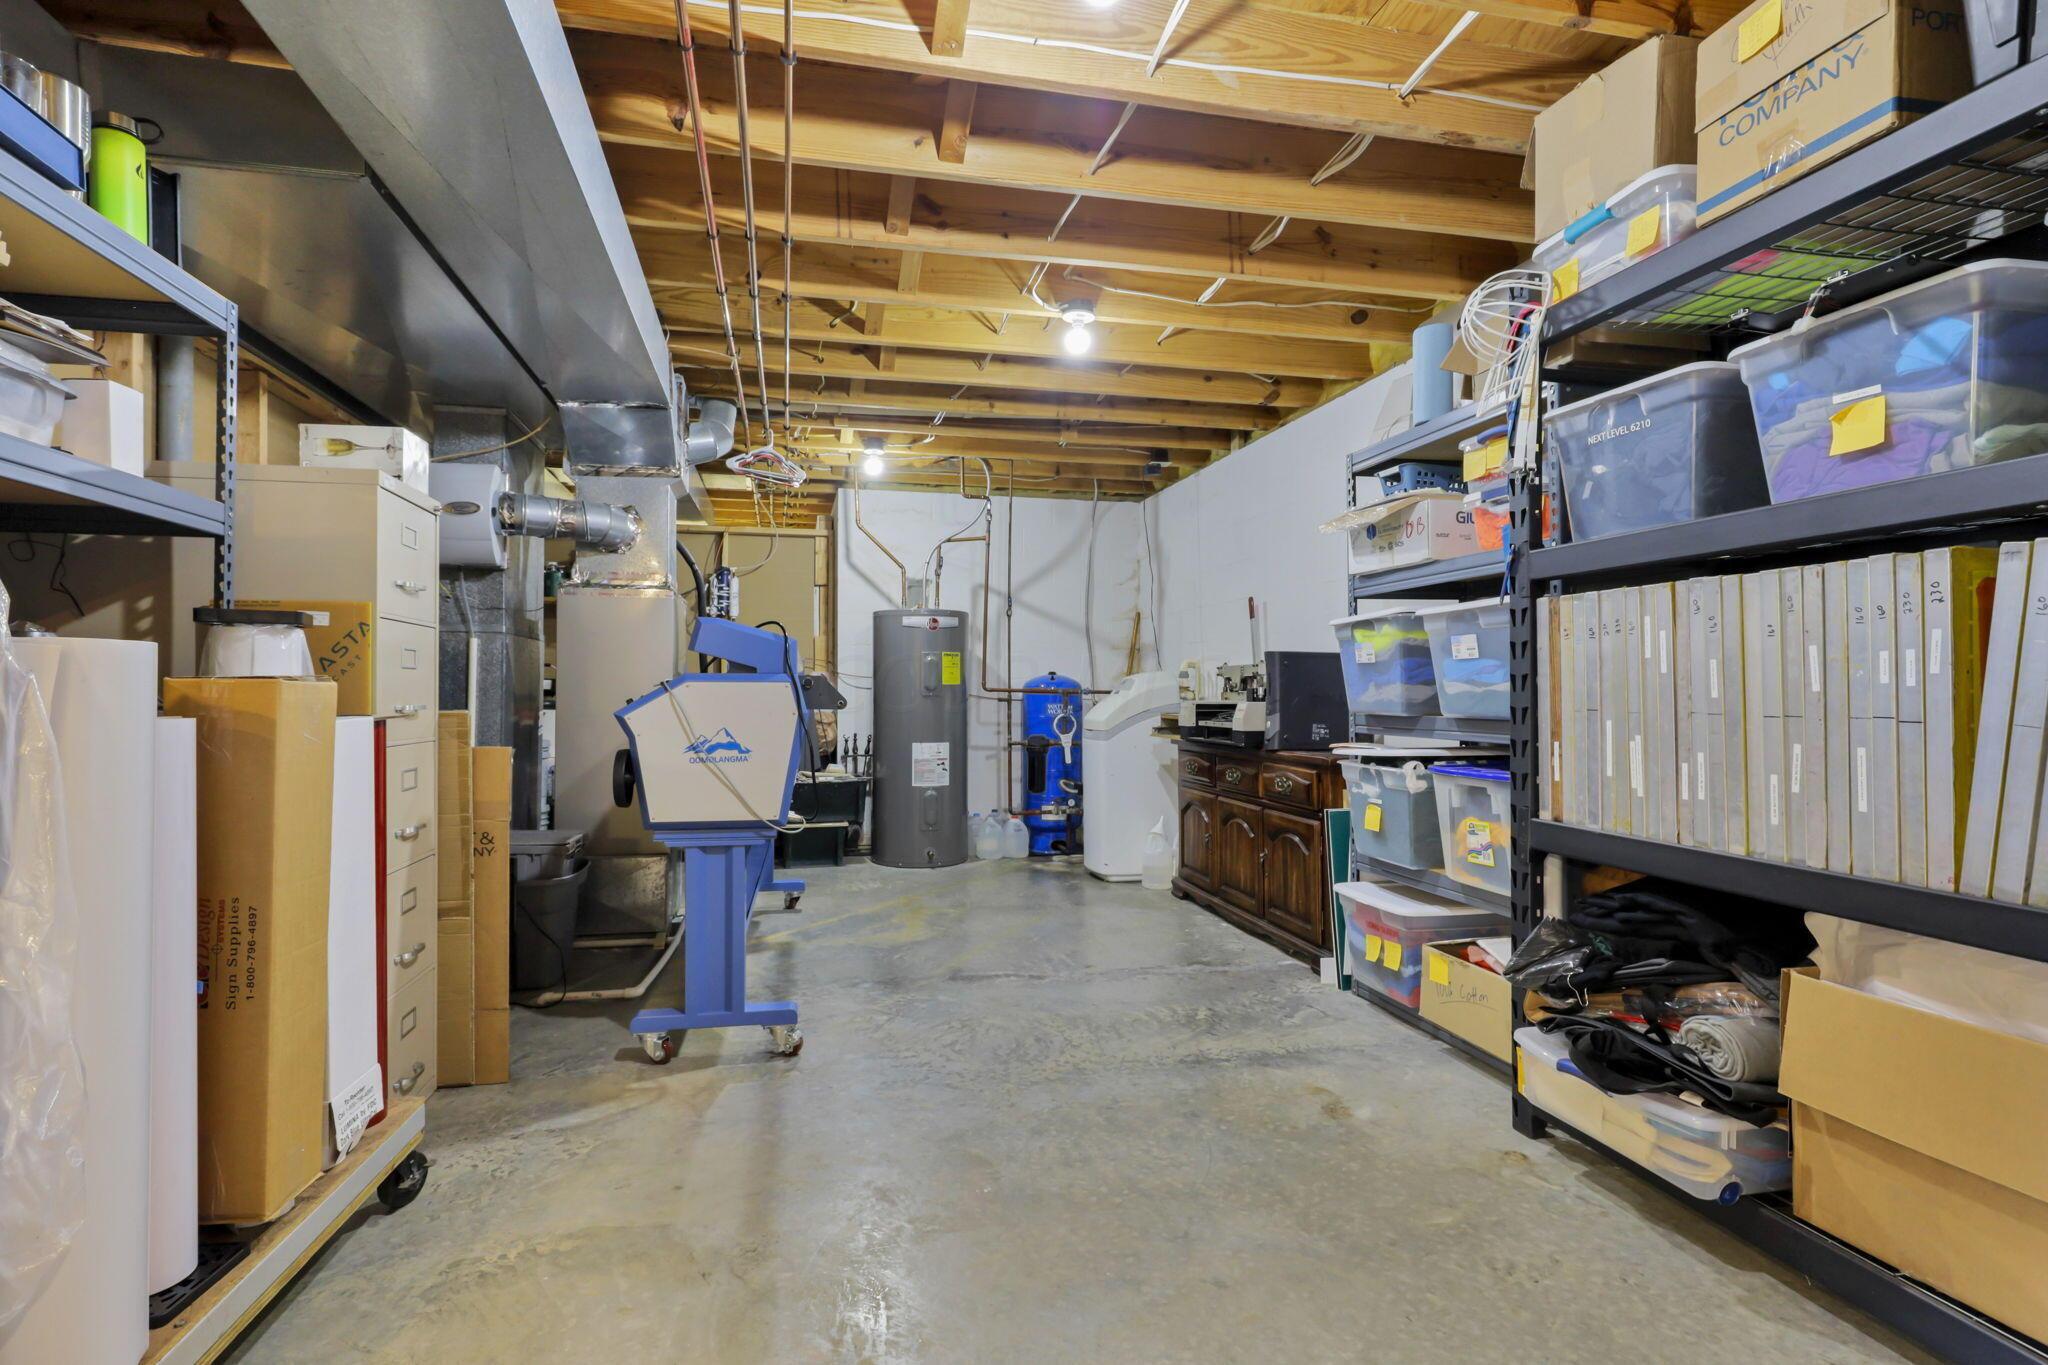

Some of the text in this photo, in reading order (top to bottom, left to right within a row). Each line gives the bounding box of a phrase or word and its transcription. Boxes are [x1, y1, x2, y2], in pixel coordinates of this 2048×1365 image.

[1911, 8, 1963, 32] POR
[1719, 42, 1864, 146] COMPANY
[1587, 418, 1651, 445] NEXT LEVEL 6210
[1787, 595, 1795, 612] 160
[1903, 592, 1913, 615] 230
[1930, 581, 1945, 604] 230
[1855, 607, 1864, 625] 160
[1876, 605, 1888, 620] 160
[2035, 596, 2048, 616] 160
[1708, 615, 1718, 633] 160
[480, 831, 495, 845] &
[225, 896, 241, 1010] Sign Supplies
[246, 905, 257, 1000] 1-800-796-4897
